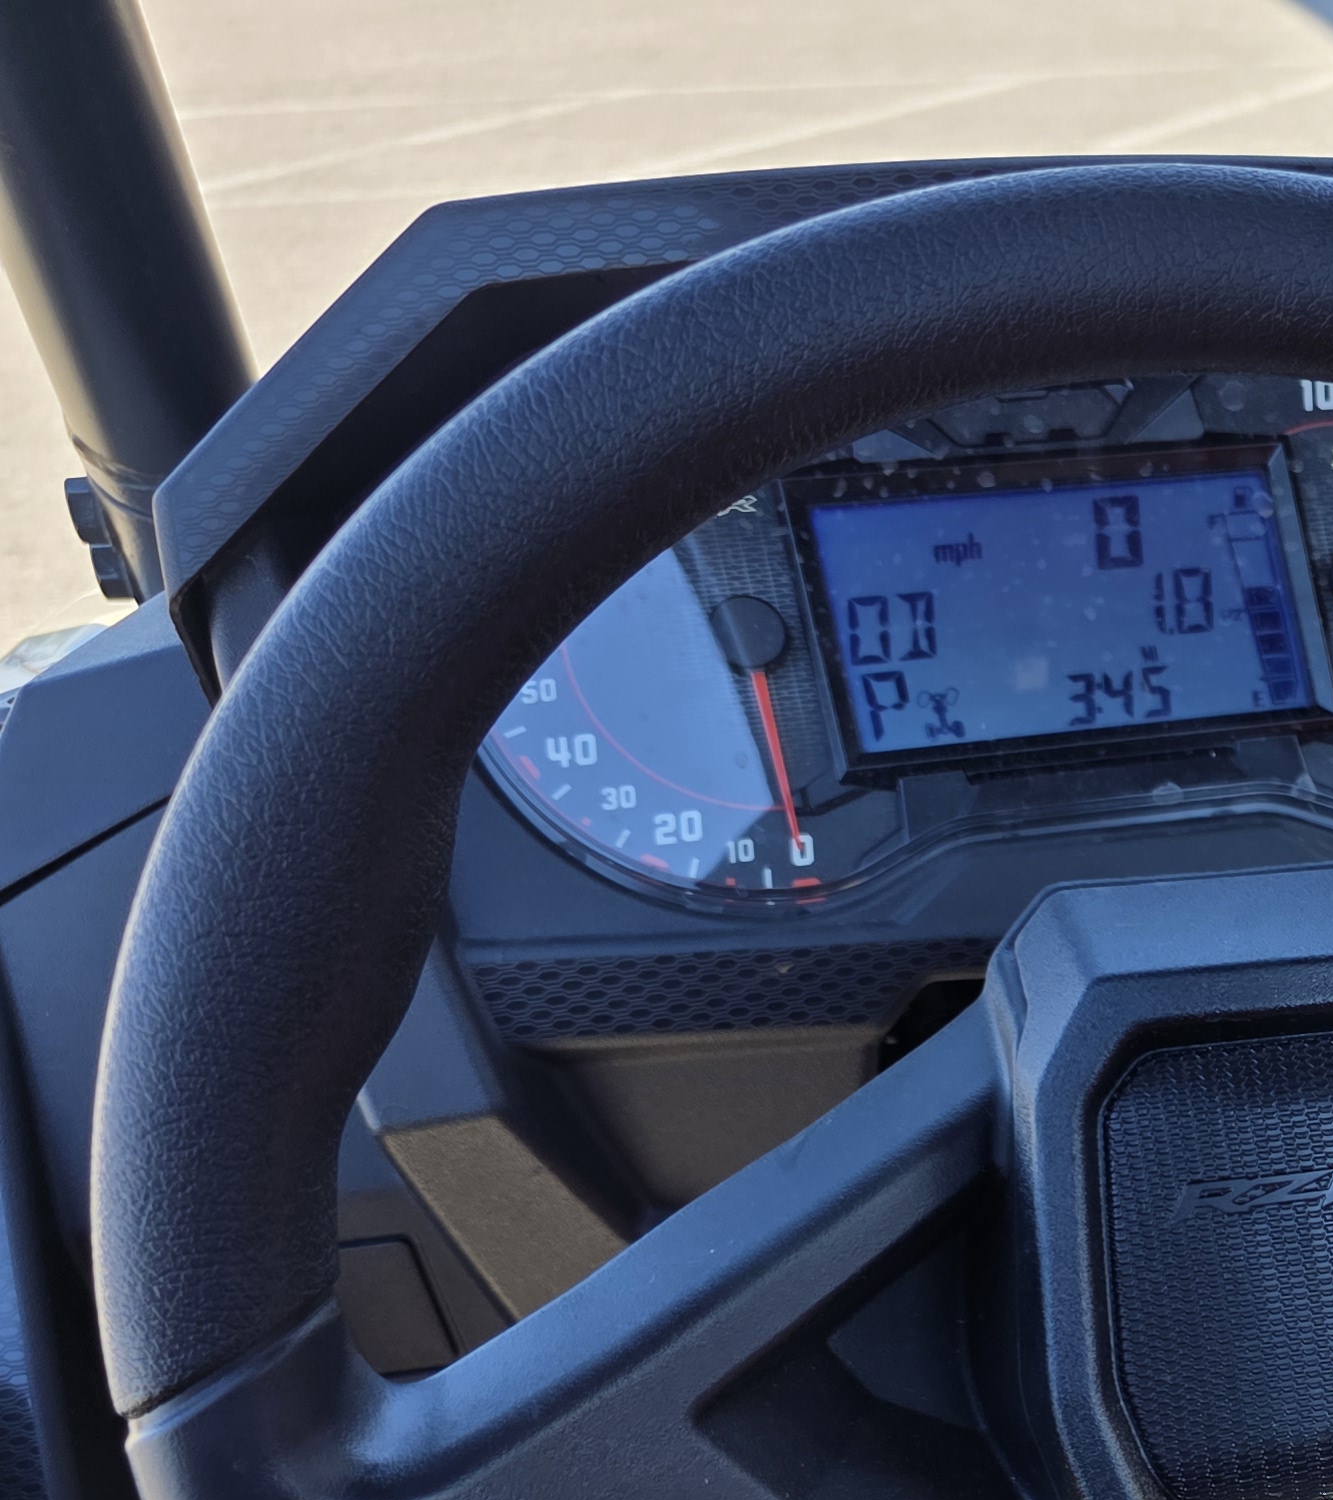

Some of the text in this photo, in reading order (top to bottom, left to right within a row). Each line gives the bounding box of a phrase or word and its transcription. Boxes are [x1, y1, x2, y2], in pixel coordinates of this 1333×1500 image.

[933, 532, 983, 567] mph
[1092, 495, 1144, 571] 0
[520, 678, 558, 705] 50
[861, 670, 910, 742] P
[1066, 664, 1172, 726] 3:45
[545, 733, 598, 768] 40
[600, 784, 637, 811] 30
[653, 809, 704, 846] 20
[725, 838, 755, 864] 10
[788, 832, 815, 867] 0
